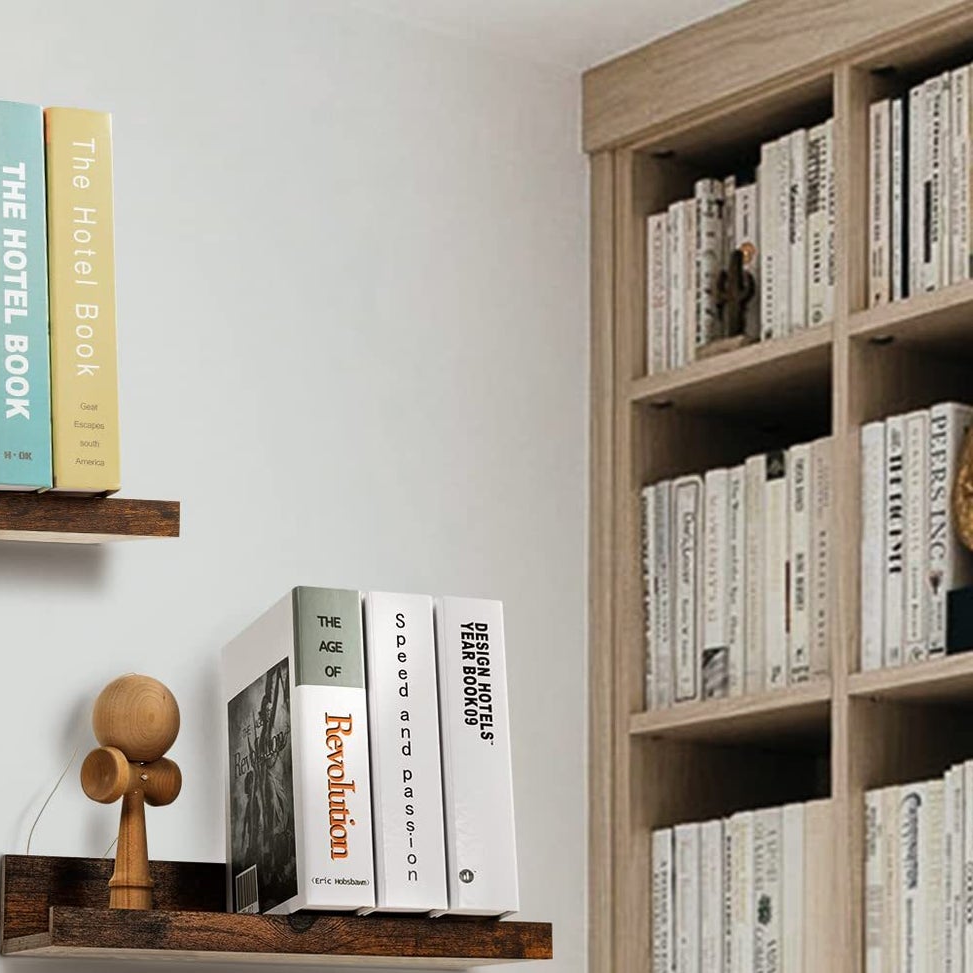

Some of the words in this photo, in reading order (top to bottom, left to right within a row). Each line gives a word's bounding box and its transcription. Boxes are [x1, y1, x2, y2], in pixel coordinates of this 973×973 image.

[2, 162, 26, 218] THE
[71, 138, 95, 190] The
[73, 206, 98, 286] Hotel
[3, 231, 29, 324] HOTEL
[75, 303, 100, 377] Book
[3, 336, 31, 420] BOOK
[73, 419, 105, 431] Escapes
[79, 438, 100, 449] south
[75, 456, 105, 468] America
[930, 416, 947, 502] PEERS
[929, 510, 947, 561] INC
[317, 615, 341, 629] THE
[319, 641, 343, 653] AGE
[461, 622, 475, 660] YEAR
[325, 666, 341, 678] OF
[395, 613, 409, 698] Speed
[475, 623, 491, 677] DESIGN
[400, 710, 412, 757] and
[324, 712, 356, 860] Revolution
[403, 769, 417, 882] passion
